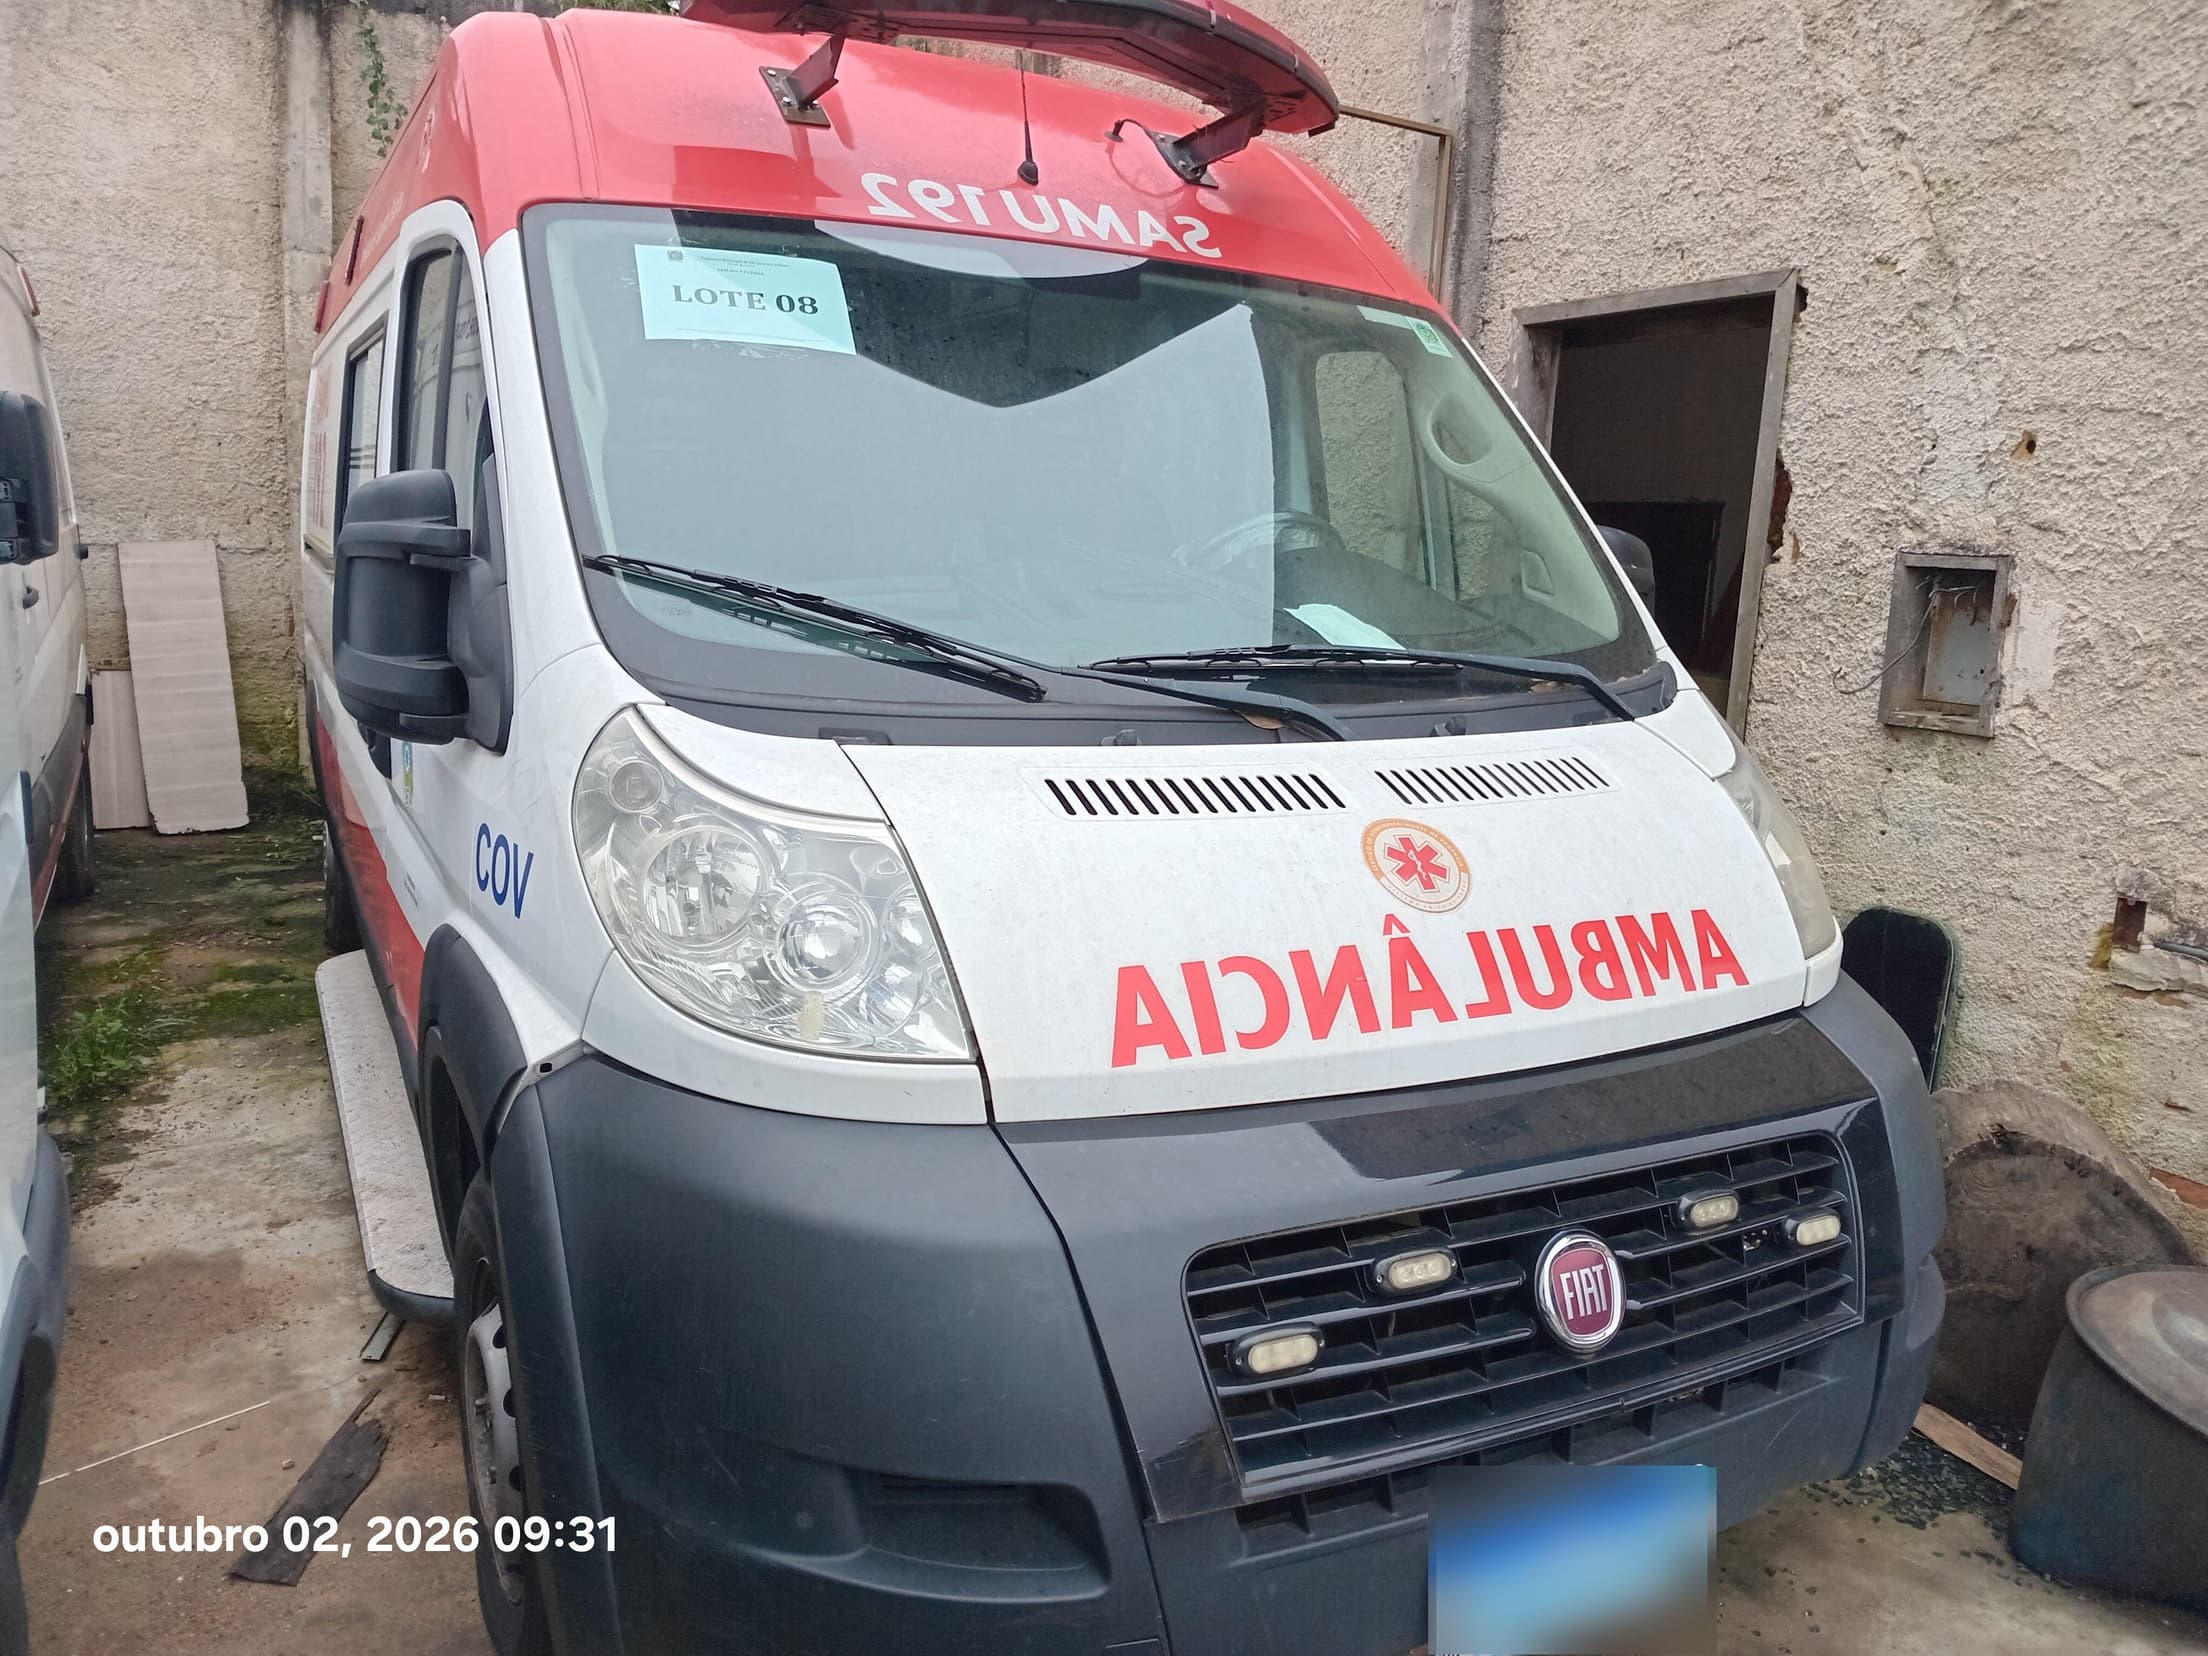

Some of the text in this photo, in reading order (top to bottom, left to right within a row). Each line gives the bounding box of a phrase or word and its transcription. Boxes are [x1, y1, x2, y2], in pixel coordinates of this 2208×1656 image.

[672, 285, 819, 315] LOTE 08
[476, 822, 535, 919] COV
[1559, 1264, 1608, 1321] FIAT
